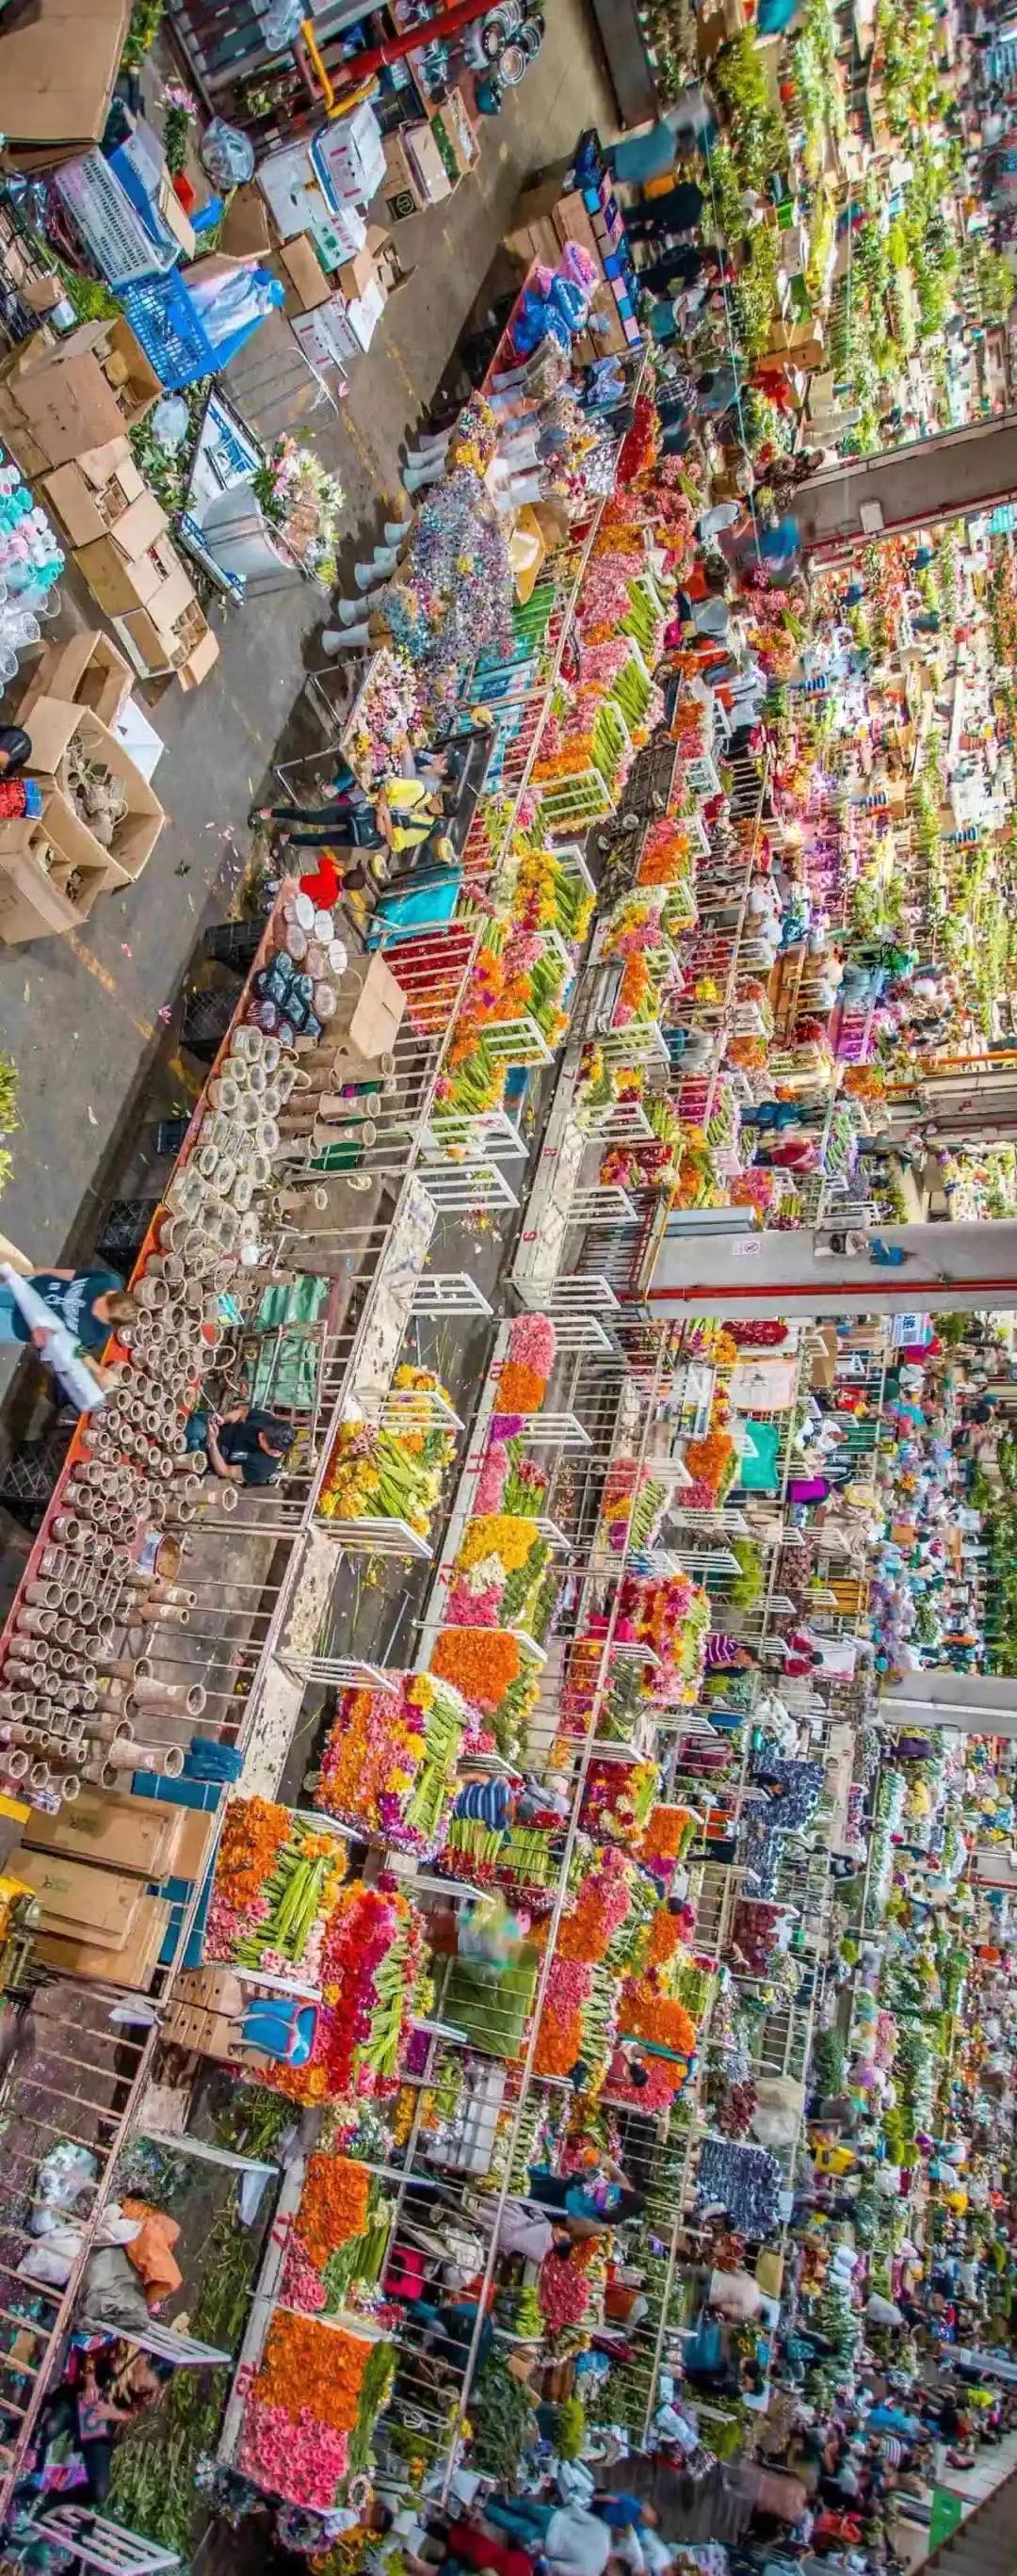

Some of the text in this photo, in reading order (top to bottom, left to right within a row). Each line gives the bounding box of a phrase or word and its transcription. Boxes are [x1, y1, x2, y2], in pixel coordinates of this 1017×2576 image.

[561, 1069, 576, 1081] 7
[522, 1230, 539, 1242] 9
[490, 1359, 506, 1381] 10
[466, 1454, 488, 1473] 11
